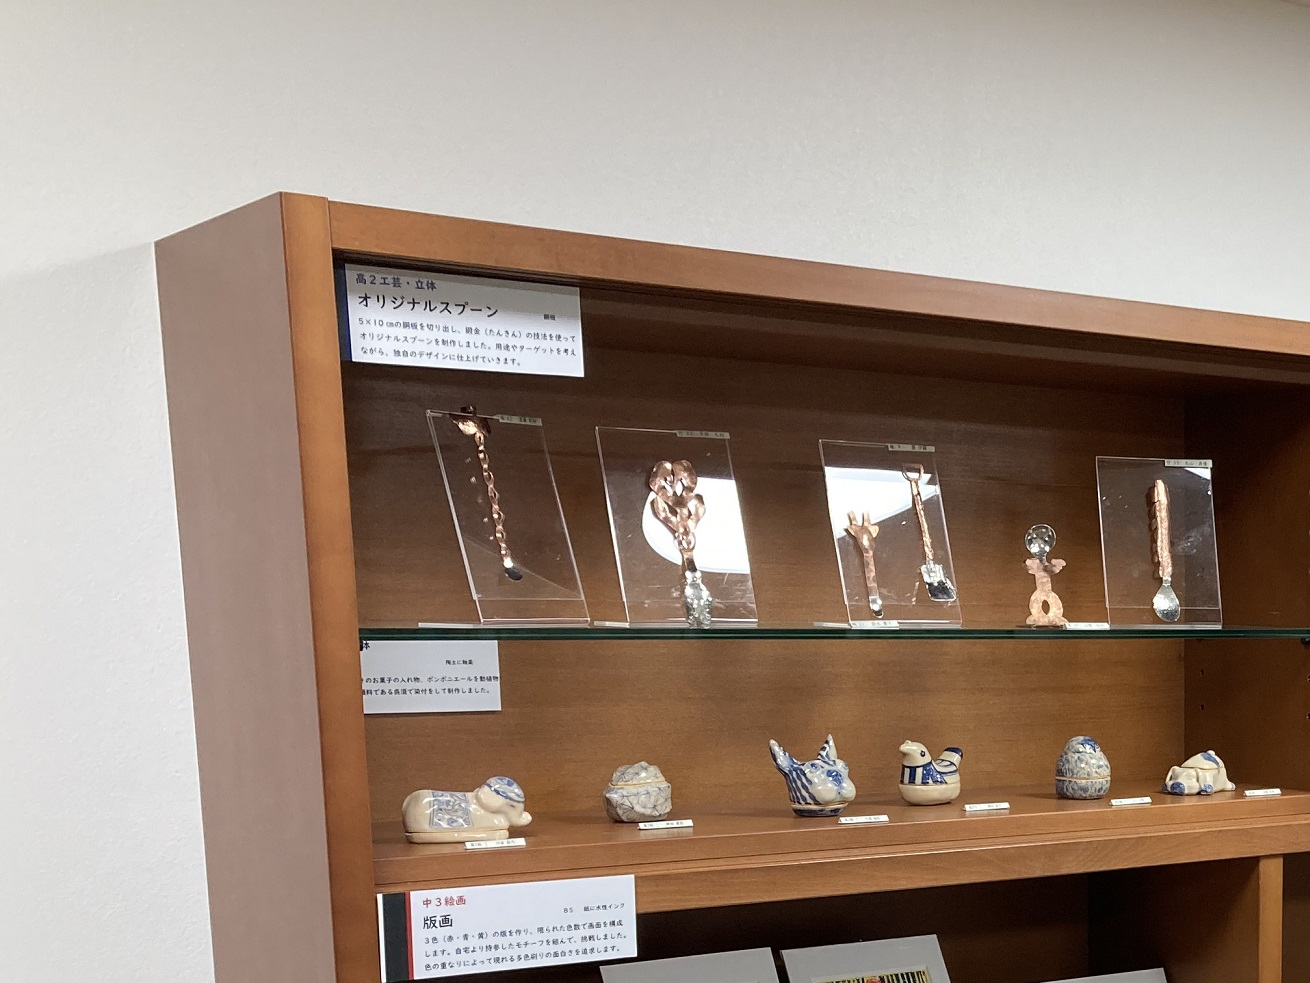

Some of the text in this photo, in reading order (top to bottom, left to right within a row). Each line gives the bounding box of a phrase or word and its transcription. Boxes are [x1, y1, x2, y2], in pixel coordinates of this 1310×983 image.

[358, 292, 499, 318] オリジナルスプーン
[422, 914, 453, 930] 版画
